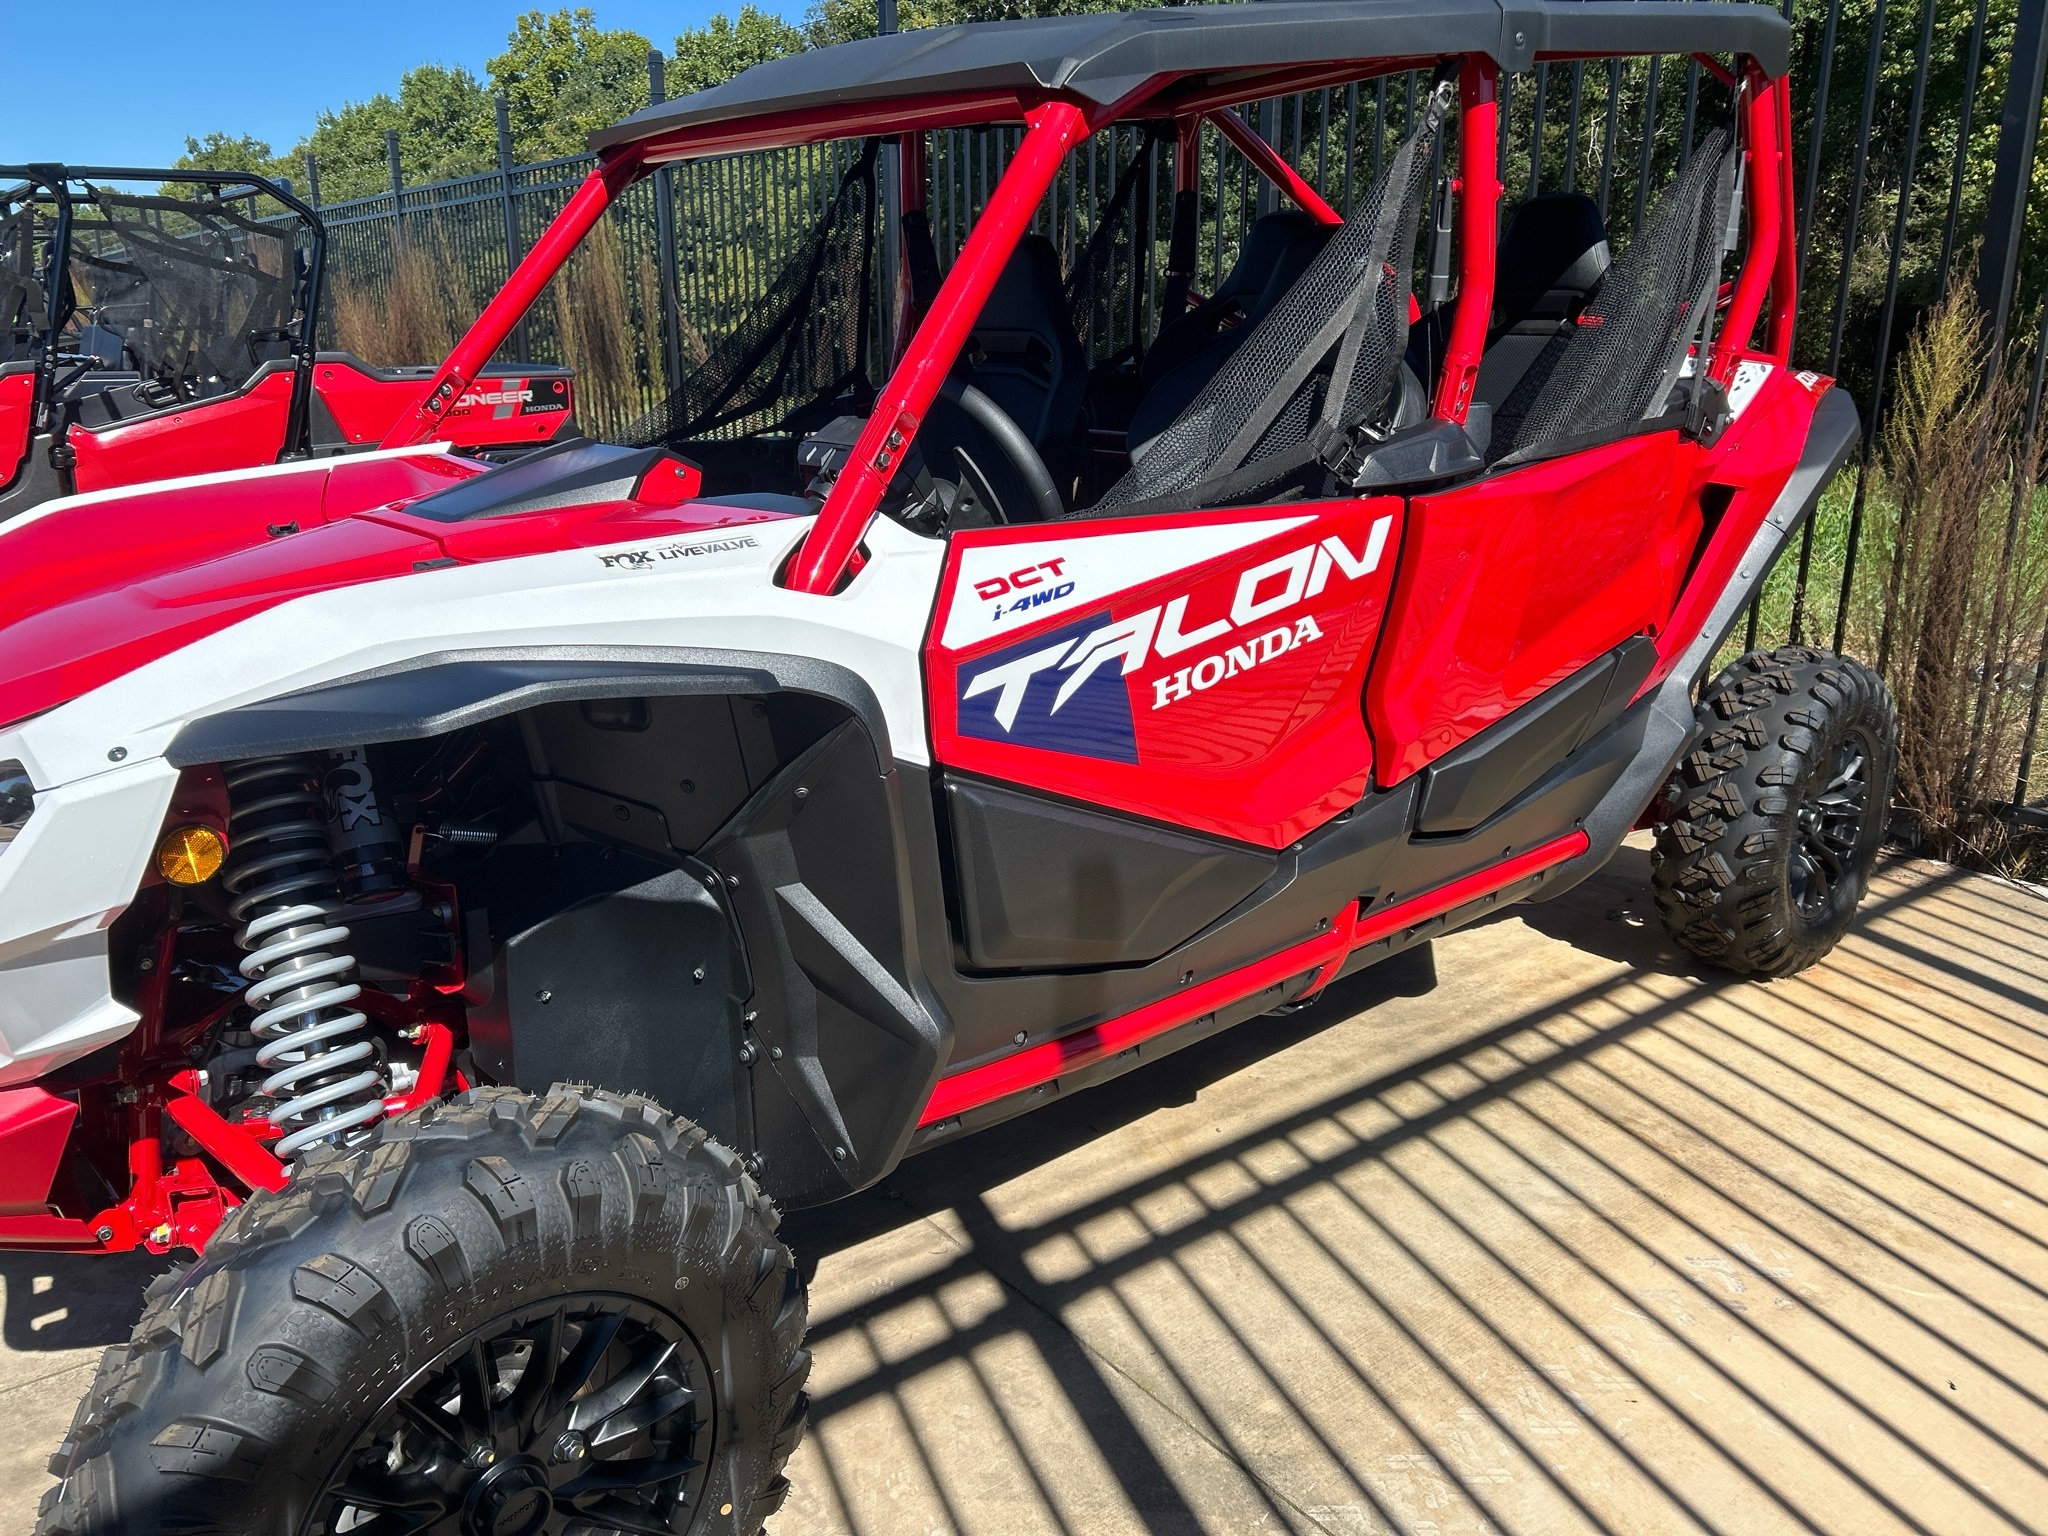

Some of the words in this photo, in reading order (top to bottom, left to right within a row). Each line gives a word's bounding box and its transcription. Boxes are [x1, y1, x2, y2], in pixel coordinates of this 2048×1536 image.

[525, 404, 564, 413] HONDA
[599, 551, 655, 570] FOX
[973, 557, 1066, 601] DCT
[962, 514, 1394, 733] TALON
[992, 581, 1075, 622] i-4WD
[1151, 615, 1323, 710] HONDA
[324, 745, 381, 831] FOX
